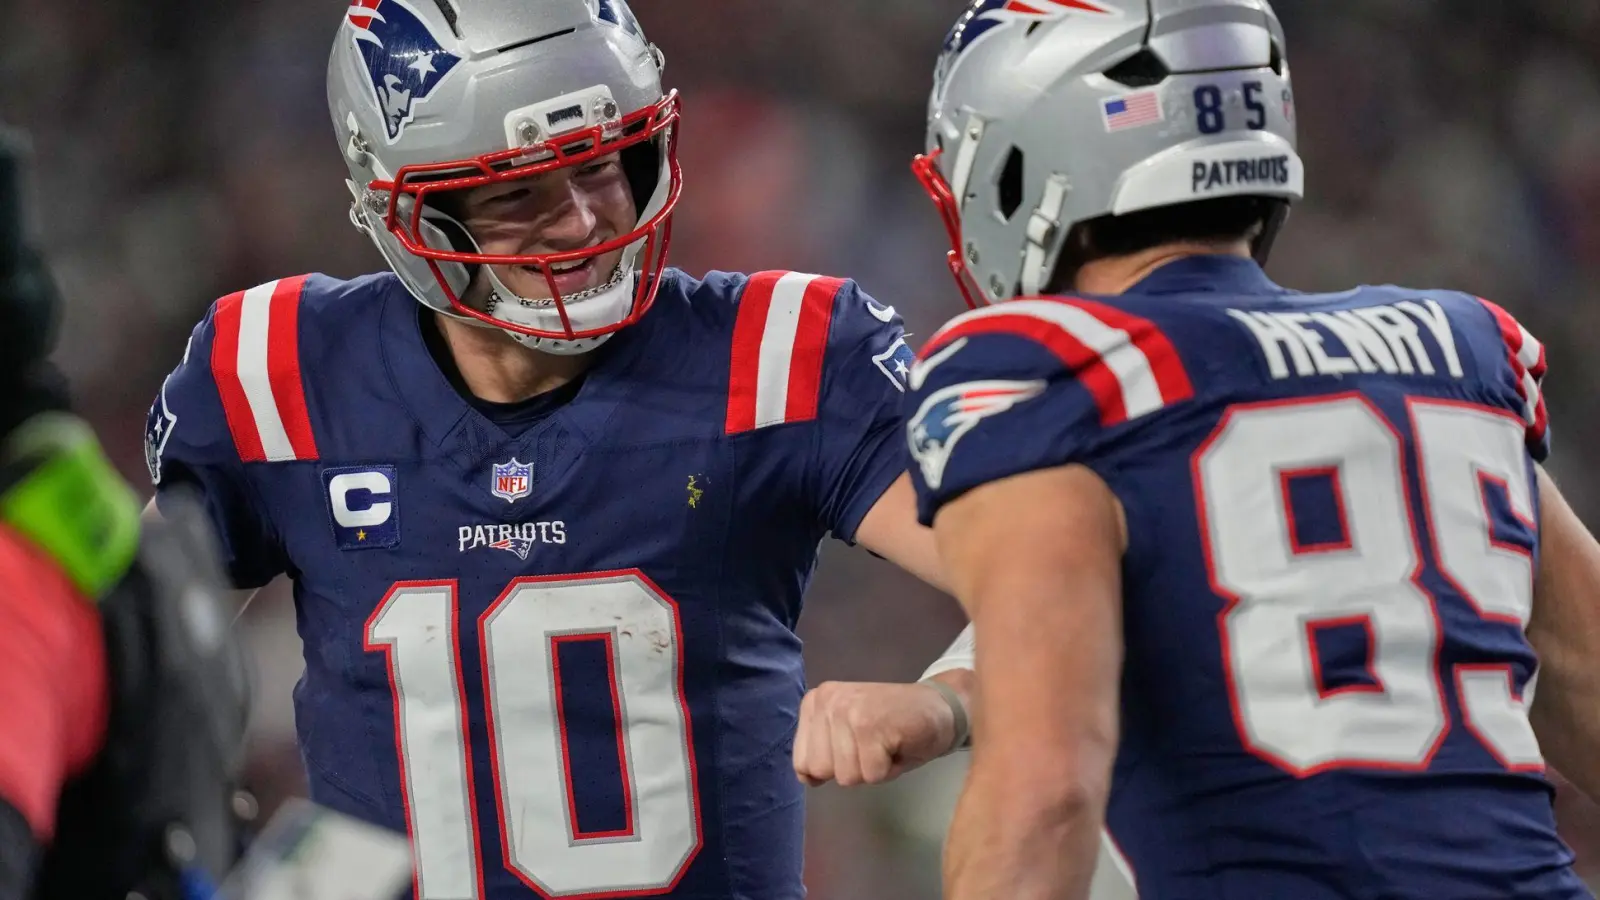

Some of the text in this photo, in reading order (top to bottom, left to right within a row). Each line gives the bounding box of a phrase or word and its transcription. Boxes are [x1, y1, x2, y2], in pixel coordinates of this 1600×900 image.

[1193, 81, 1266, 134] 85
[1192, 154, 1289, 192] PATRIOTS
[1227, 299, 1464, 380] HENRY
[329, 471, 392, 528] C
[498, 476, 526, 493] NFL
[458, 520, 566, 552] PATRIOTS
[1190, 391, 1545, 778] 85
[364, 568, 703, 900] 10
